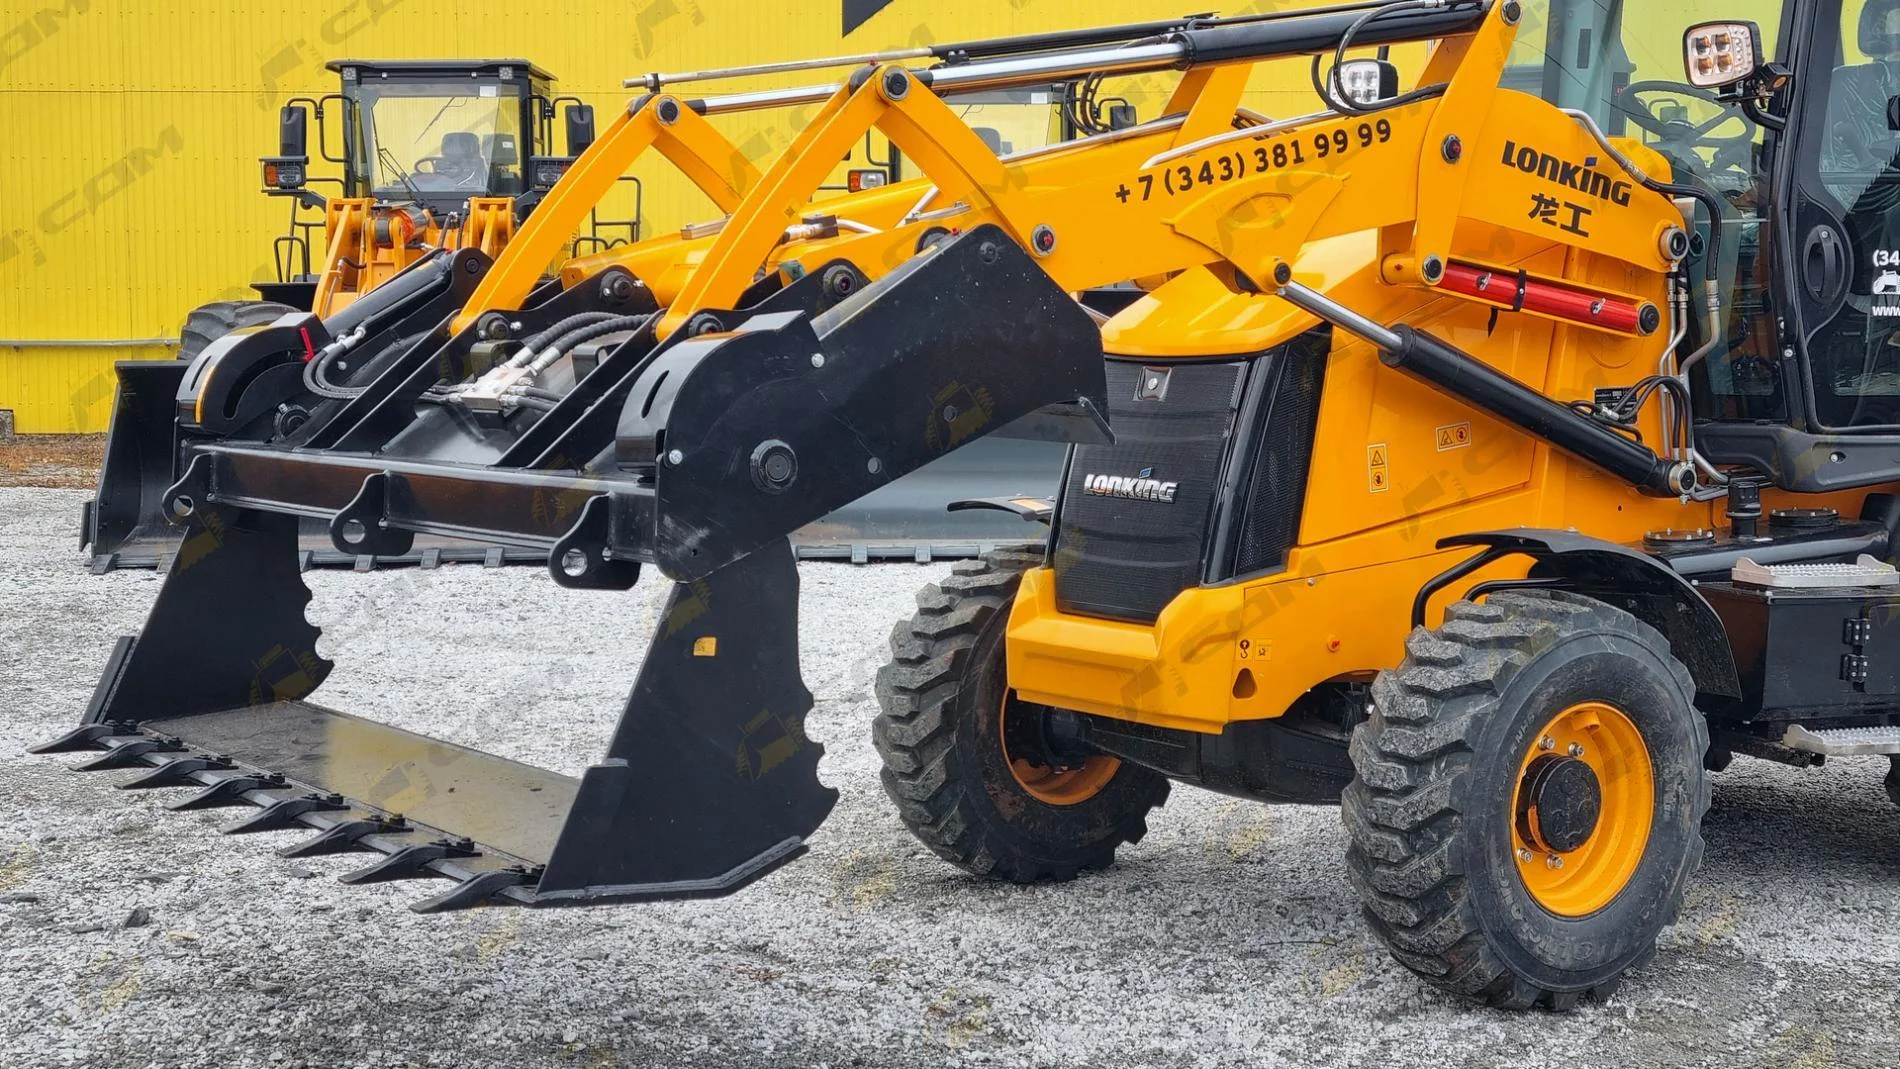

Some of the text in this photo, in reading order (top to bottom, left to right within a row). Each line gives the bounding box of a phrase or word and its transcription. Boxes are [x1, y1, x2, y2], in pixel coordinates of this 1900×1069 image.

[1164, 152, 1246, 197] (343)
[1254, 139, 1305, 173] 381
[1314, 129, 1349, 158] 99
[1358, 118, 1392, 148] 99
